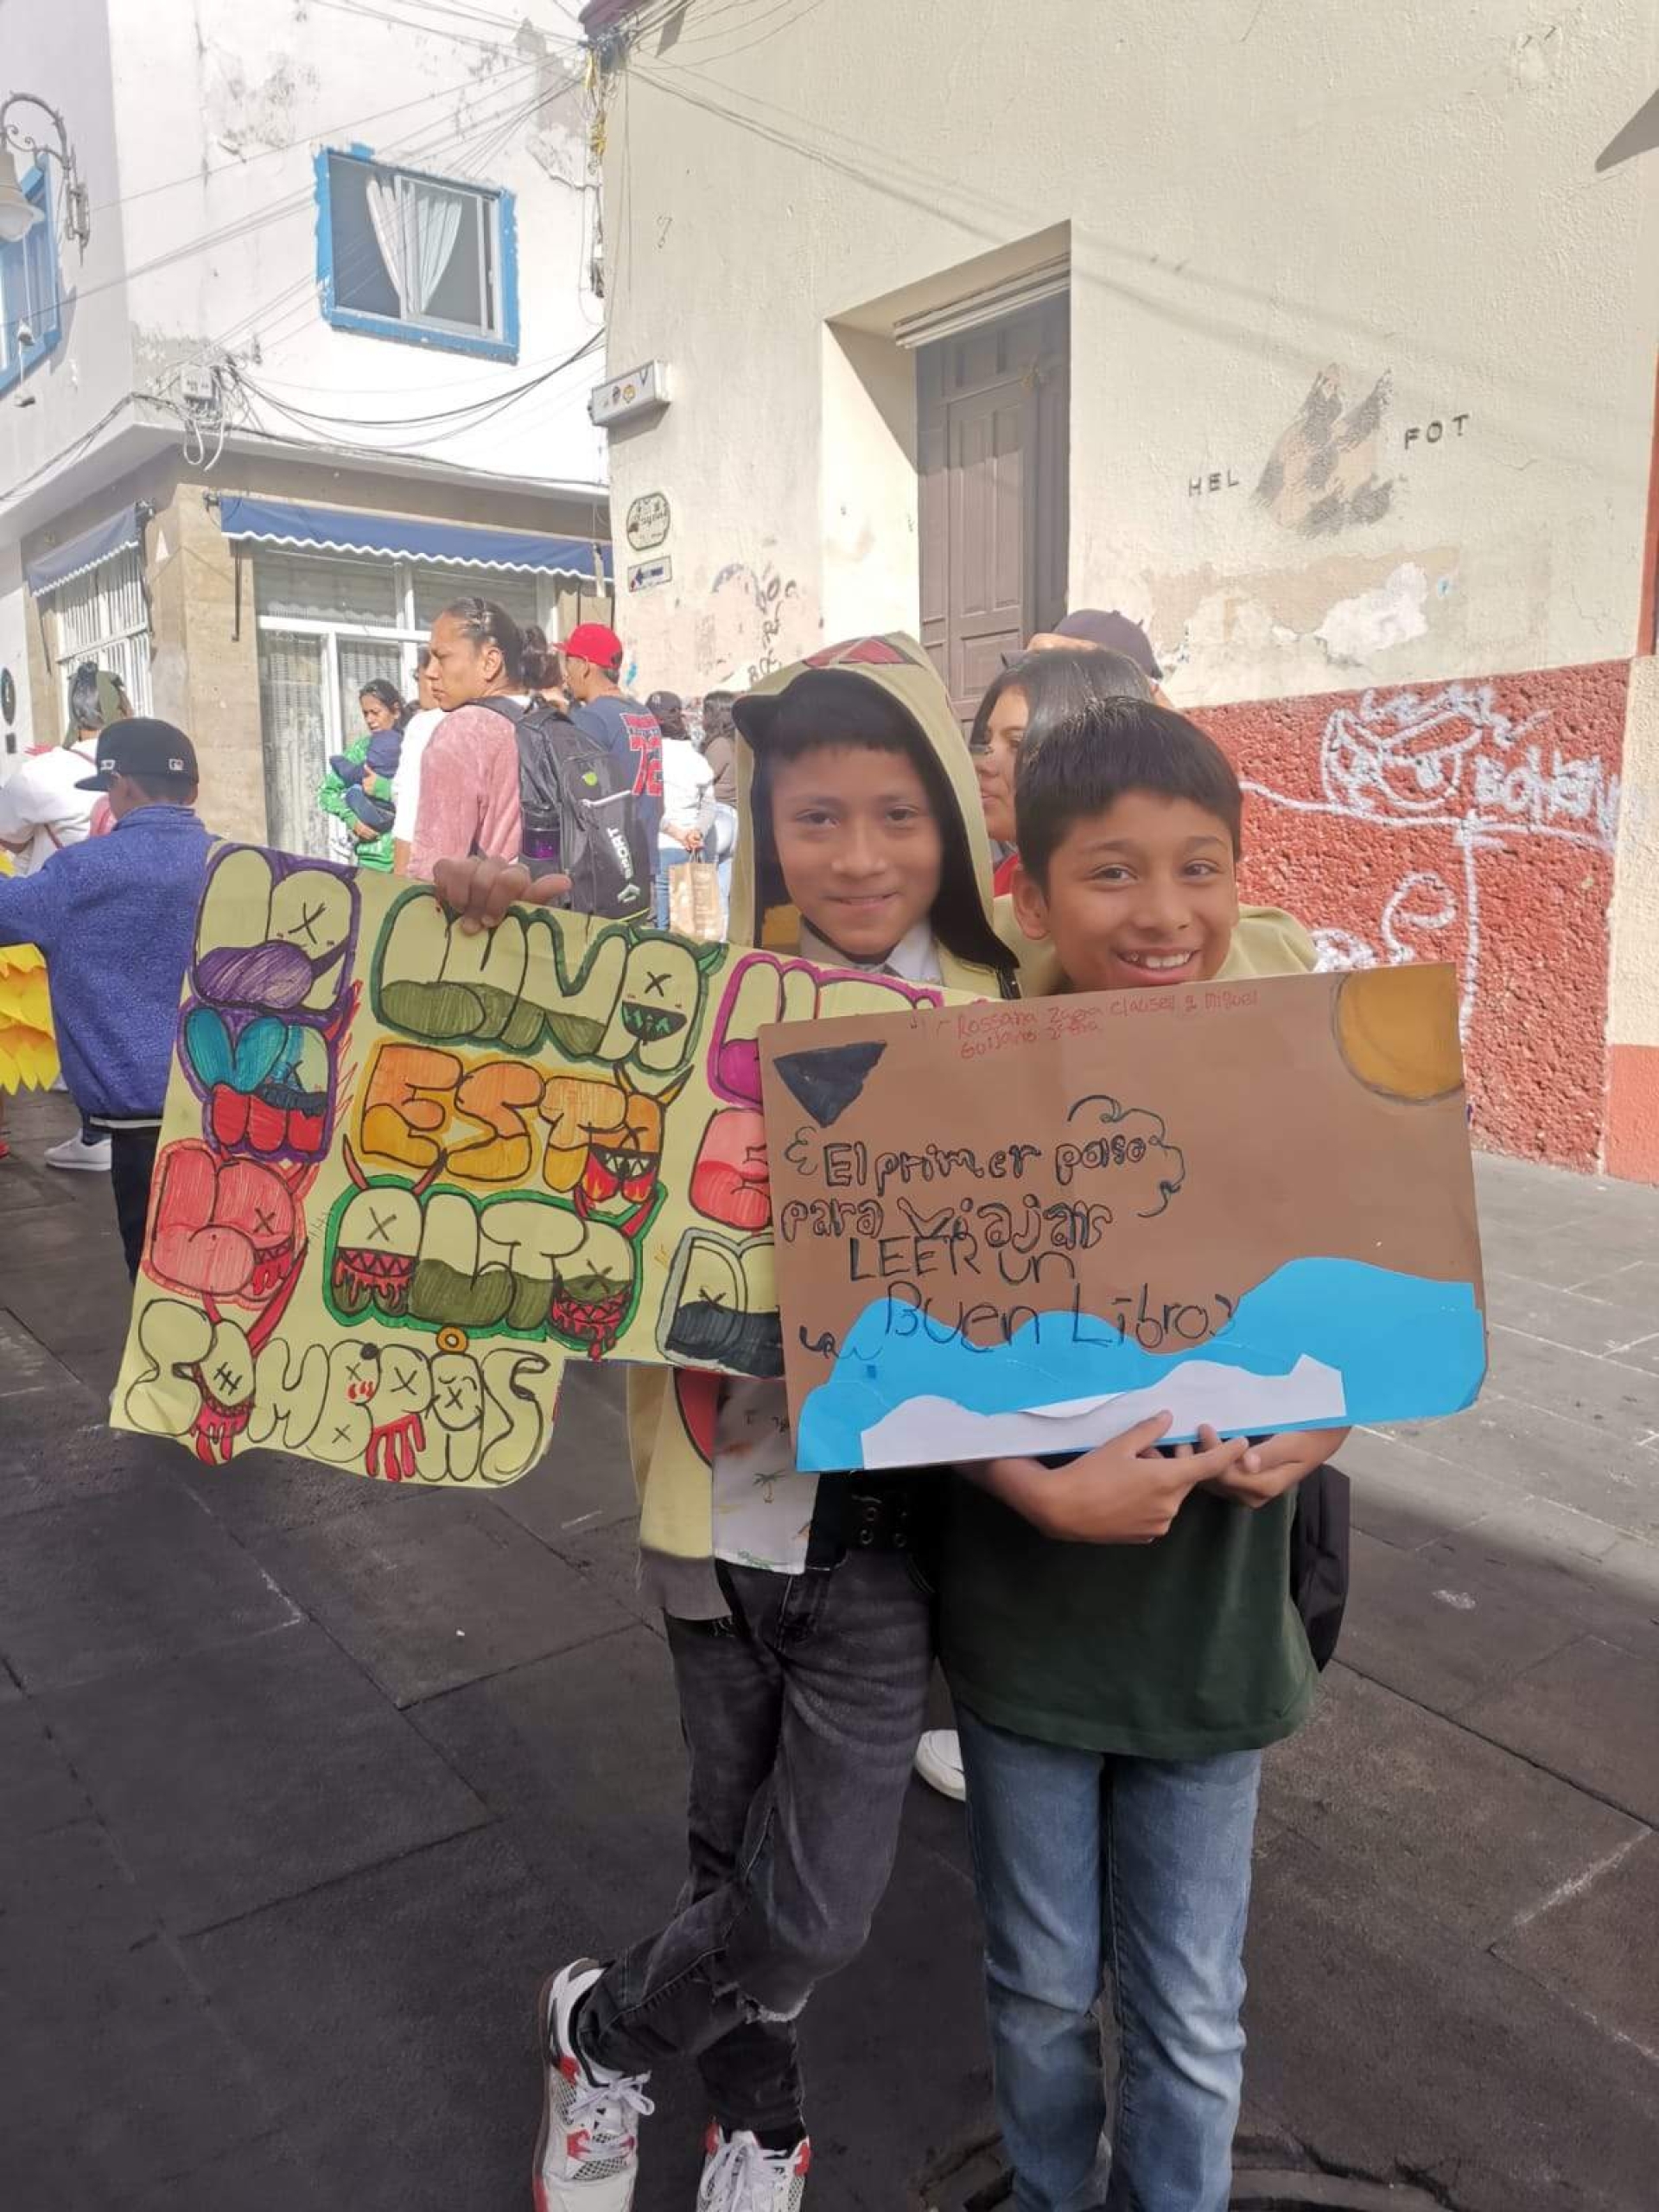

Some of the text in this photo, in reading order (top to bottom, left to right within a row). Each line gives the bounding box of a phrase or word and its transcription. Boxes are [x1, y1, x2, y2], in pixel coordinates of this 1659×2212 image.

[1403, 414, 1469, 449] FOT
[823, 1135, 1147, 1198] El primer paso
[781, 1198, 885, 1243] para
[849, 1234, 981, 1282] LEER
[885, 1281, 1210, 1353] Buen Libro
